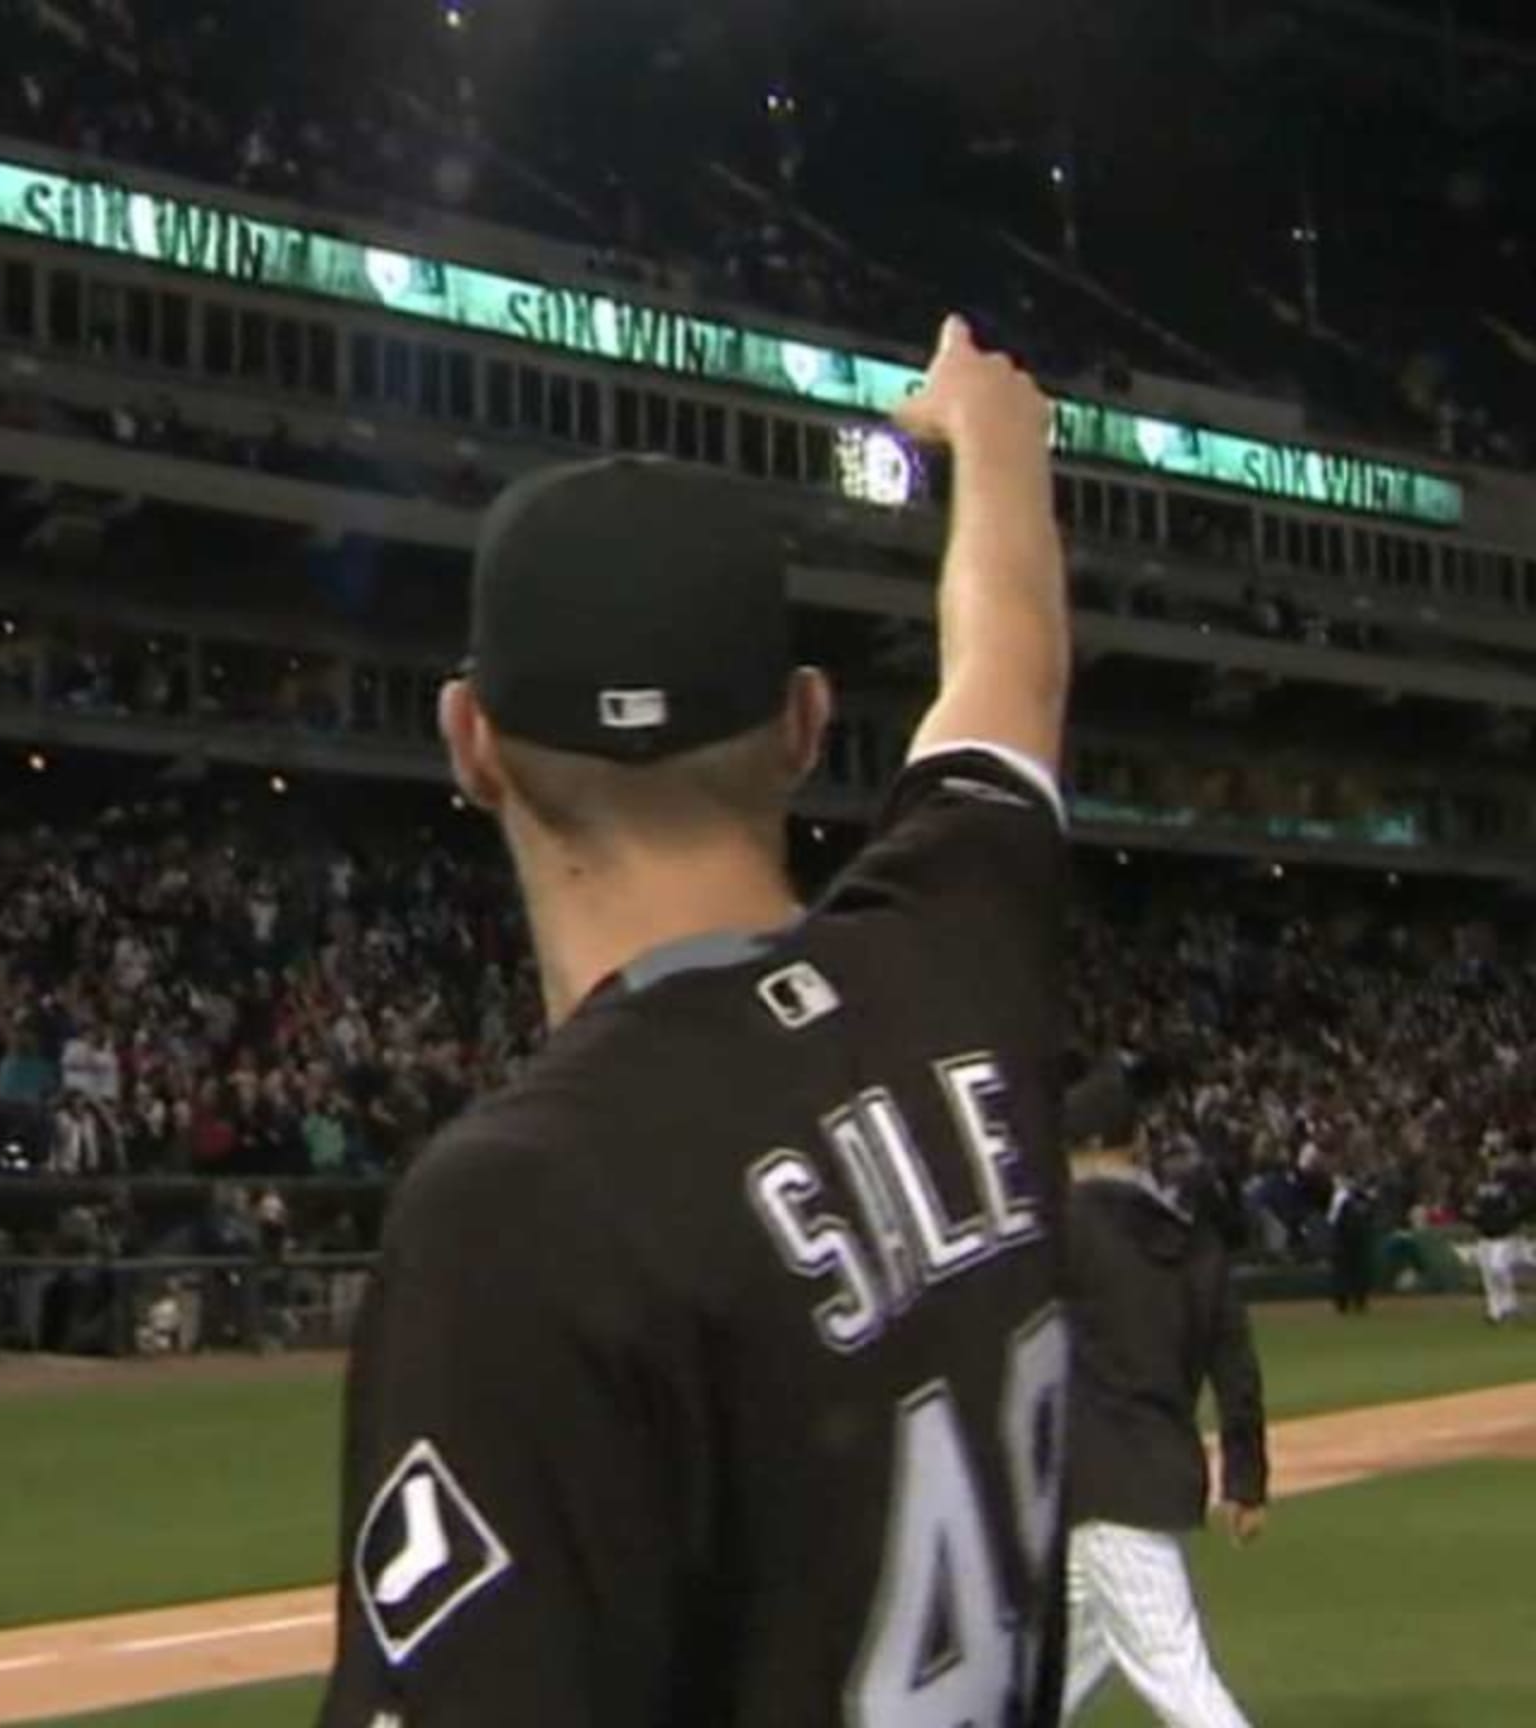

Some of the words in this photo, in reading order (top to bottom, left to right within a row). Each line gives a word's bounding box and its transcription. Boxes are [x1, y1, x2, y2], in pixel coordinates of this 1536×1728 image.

[23, 180, 132, 252] SOX
[151, 199, 265, 282] WIN
[507, 288, 598, 353] SOX
[614, 302, 709, 377] WIN
[746, 1050, 1048, 1355] SALE
